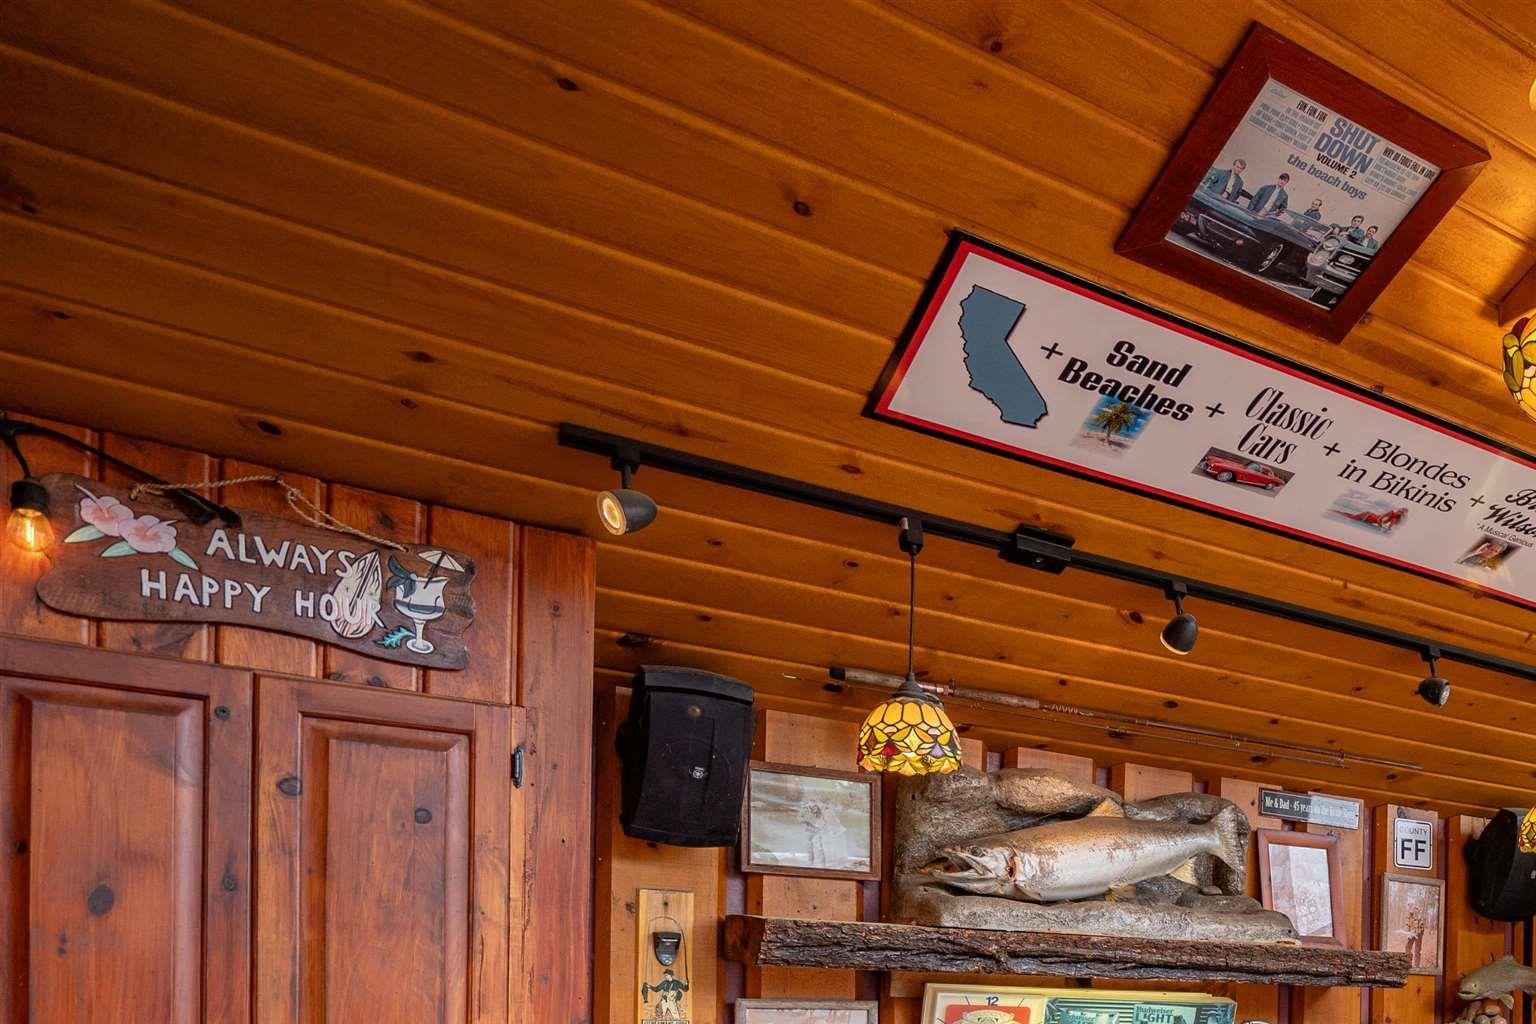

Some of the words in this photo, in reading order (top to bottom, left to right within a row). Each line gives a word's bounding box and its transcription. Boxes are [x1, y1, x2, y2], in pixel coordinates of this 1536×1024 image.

[1314, 132, 1374, 174] DOWN
[1330, 117, 1381, 155] SHUT
[1287, 153, 1306, 171] the
[1307, 161, 1342, 187] beach
[1341, 180, 1368, 200] boys
[1316, 152, 1350, 175] VOLUME
[1349, 170, 1357, 179] 2
[1106, 340, 1193, 388] Sand
[1057, 356, 1194, 422] Beaches
[1245, 386, 1335, 440] Classic
[1237, 423, 1298, 464] Cars
[1364, 438, 1471, 489] Blondes
[1337, 459, 1368, 484] in
[1369, 471, 1458, 513] Bikinis
[205, 528, 356, 578] ALWAYS
[140, 568, 272, 614] HAPPY
[295, 589, 385, 629] HOUR
[1401, 838, 1427, 861] FF
[986, 996, 999, 1006] 12
